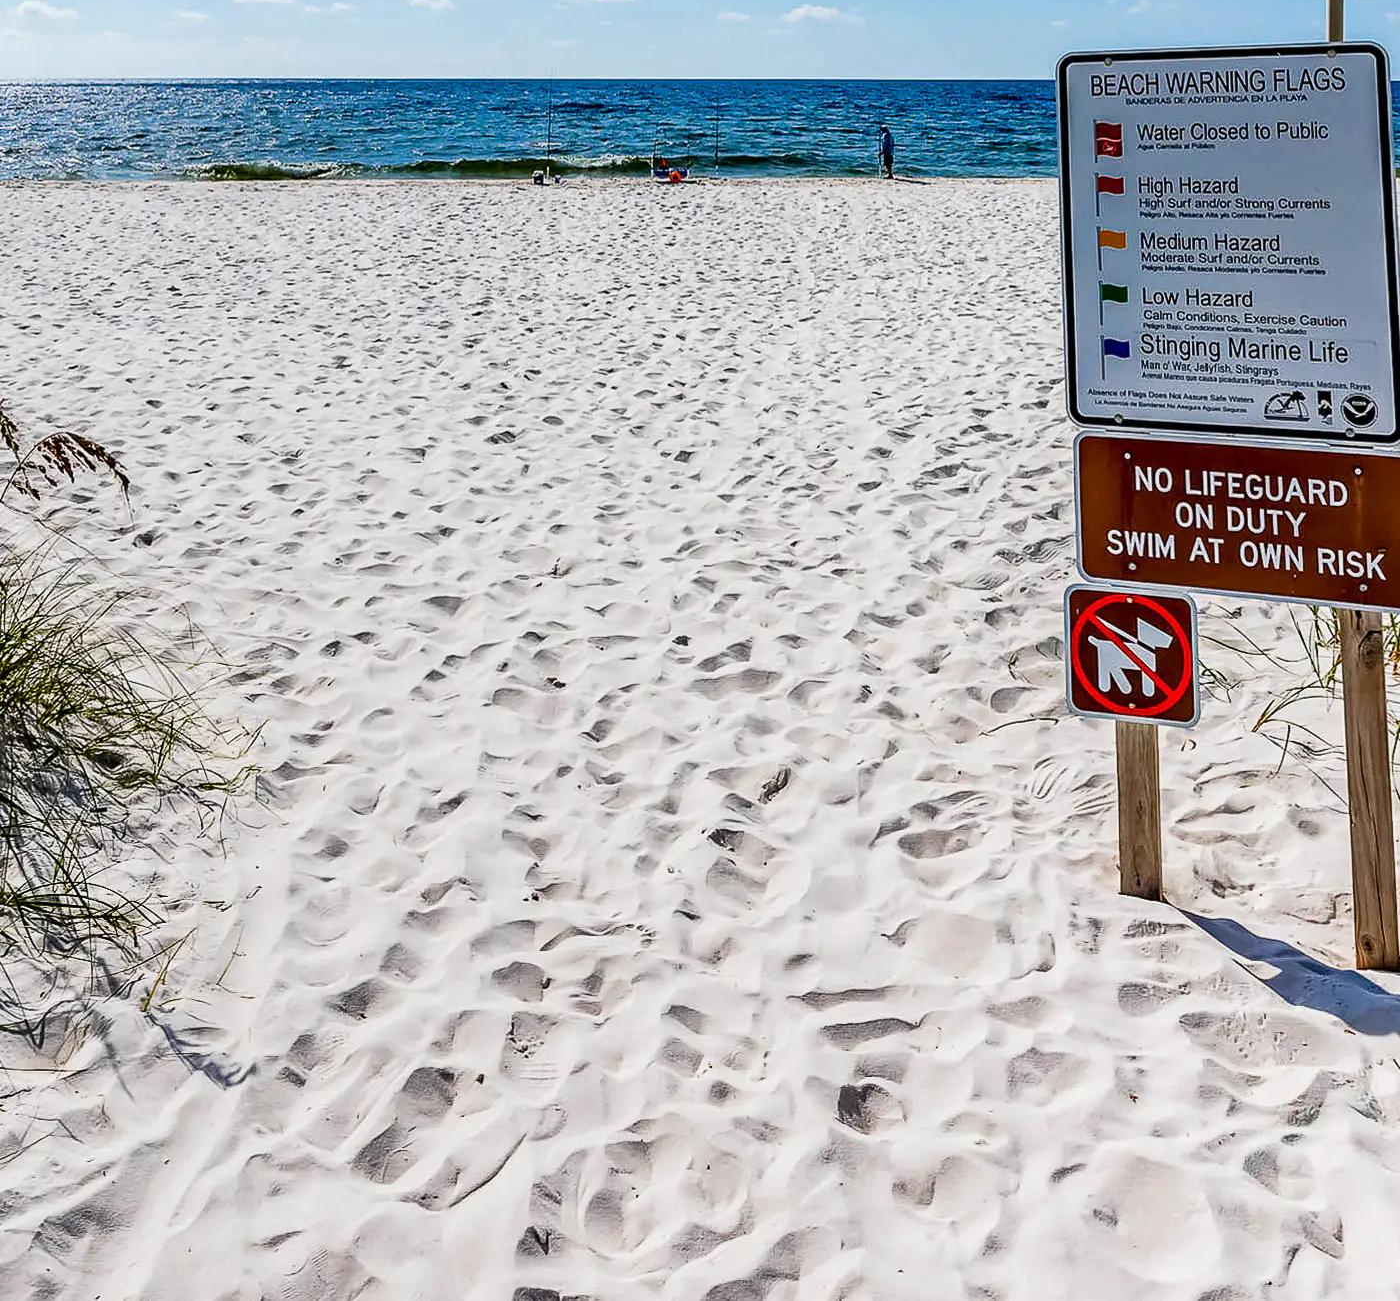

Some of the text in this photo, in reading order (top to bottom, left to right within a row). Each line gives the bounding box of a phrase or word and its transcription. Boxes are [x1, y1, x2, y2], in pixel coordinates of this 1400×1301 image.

[1090, 67, 1346, 97] BEACH WARNING FLAGS
[1125, 97, 1172, 105] BANDERAS
[1173, 96, 1186, 104] DE
[1187, 95, 1249, 104] ADVERTENCIA
[1250, 95, 1264, 103] EN
[1279, 94, 1308, 102] PLAYA
[1136, 121, 1329, 141] Water Closed to Public
[1138, 176, 1239, 198] High Hazard
[1139, 198, 1332, 211] High Surf and/or Strong Currents
[1140, 232, 1280, 252] Medium Hazard
[1141, 252, 1320, 266] Moderate Surf and/or Currents
[1142, 287, 1253, 308] Low Hazard
[1143, 309, 1347, 327] Calm Conditions, Exercise Caution
[1140, 333, 1350, 364] Stinging Marine Life
[1141, 359, 1161, 371] Man
[1172, 361, 1192, 373] War,
[1194, 363, 1233, 376] Jellyfish,
[1235, 364, 1279, 377] Stingrays
[1198, 375, 1218, 383] causa
[1218, 376, 1249, 384] picaduras
[1350, 383, 1372, 392] Rayas
[1088, 388, 1255, 404] Absence of Flags Does Not Assure Safe Waters
[1134, 465, 1349, 507] NO LIFEGUARD
[1175, 502, 1307, 537] ON DUTY
[1106, 529, 1387, 581] SWIM AT OWN RISK
